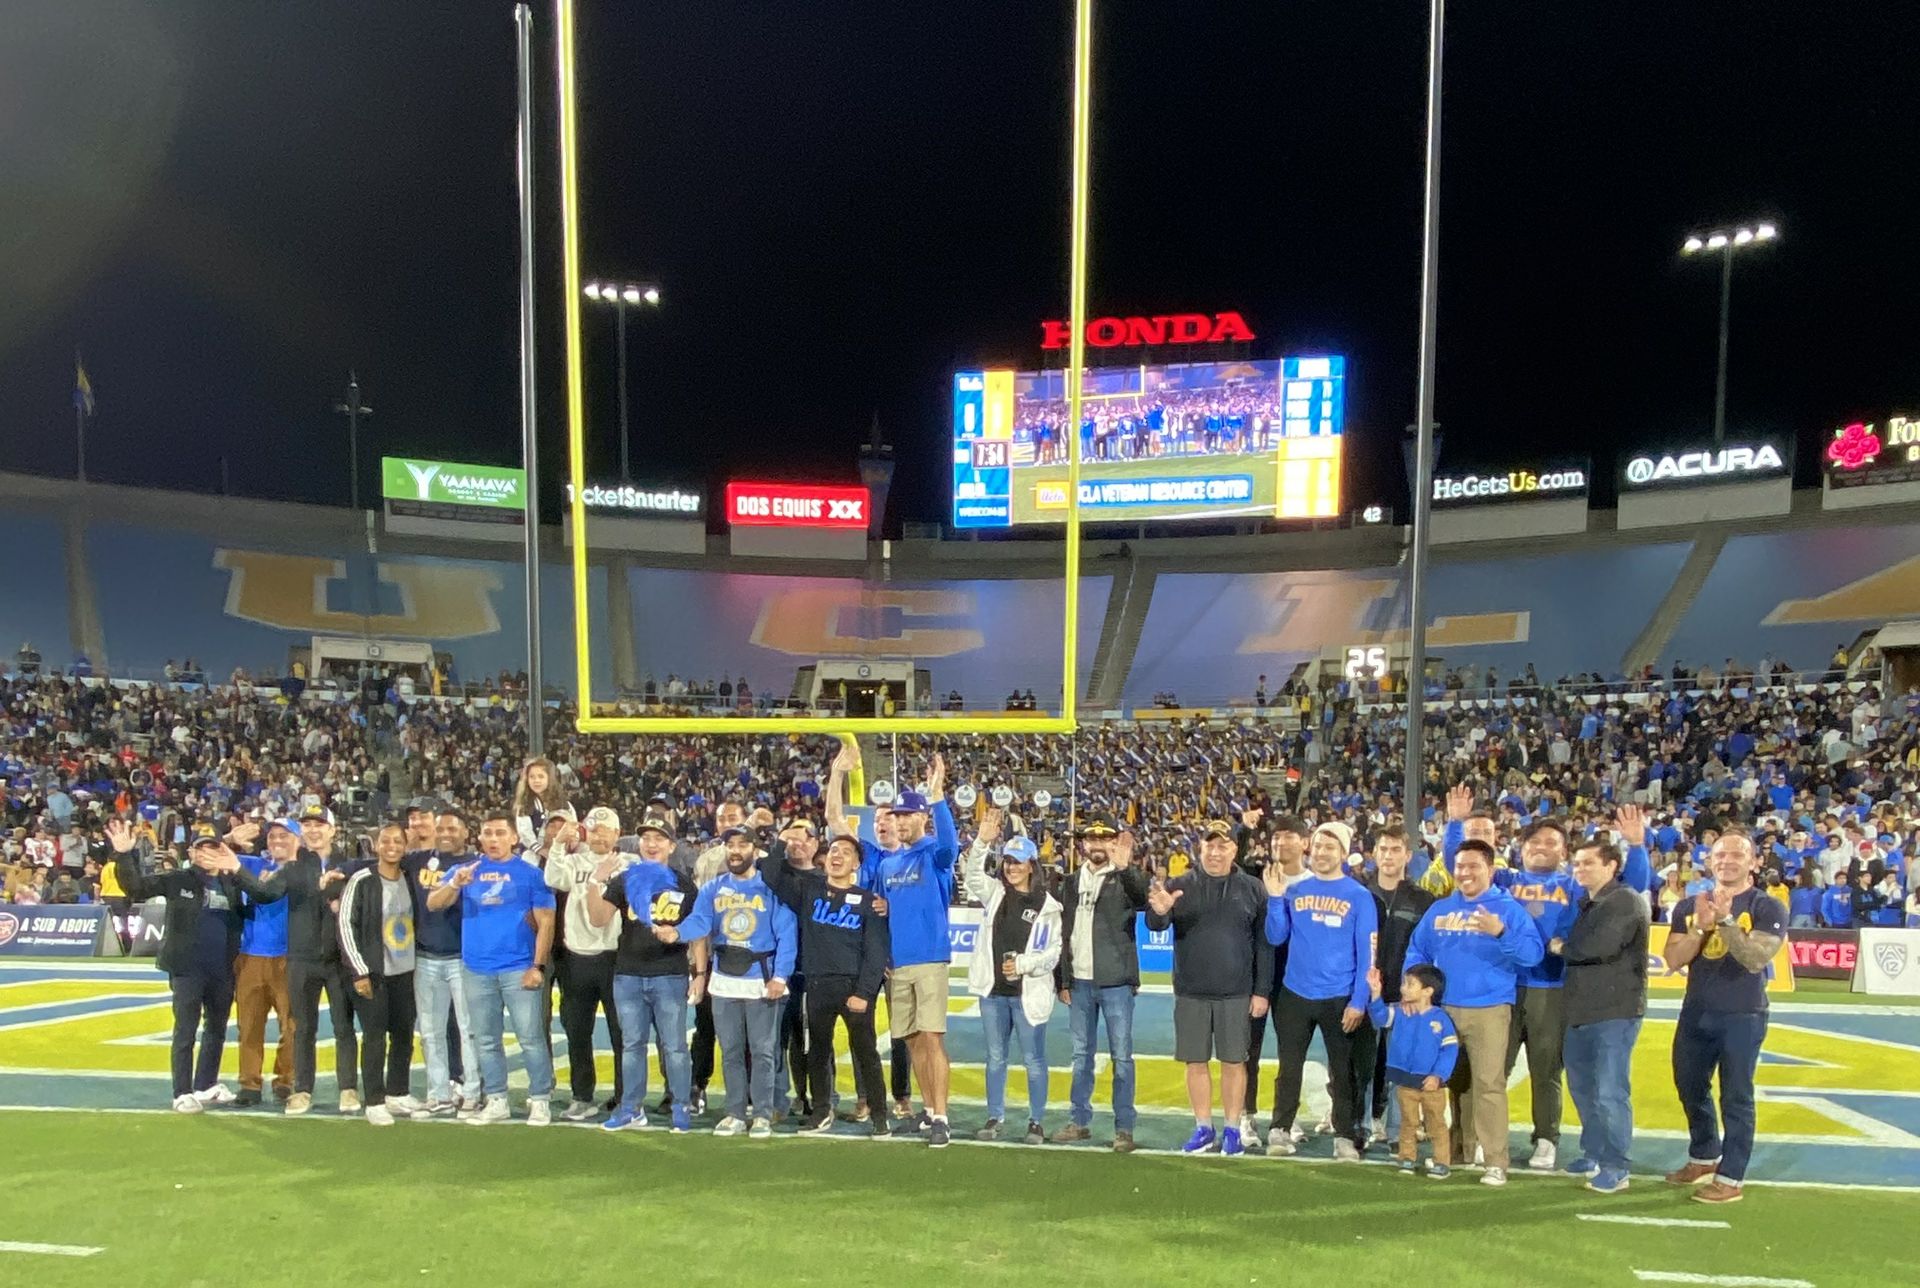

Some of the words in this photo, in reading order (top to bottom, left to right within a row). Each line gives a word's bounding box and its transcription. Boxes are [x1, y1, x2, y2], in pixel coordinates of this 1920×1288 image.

[1042, 312, 1254, 349] HONDA
[1652, 446, 1783, 480] ACURA
[566, 485, 700, 512] TcketSmarter
[1078, 486, 1101, 502] CLA
[1433, 471, 1585, 500] HeGetsUs.com
[736, 495, 769, 516] DOS
[772, 497, 824, 519] EQUIS
[828, 499, 863, 521] XX
[1346, 648, 1385, 679] 25
[480, 872, 511, 882] UCLA
[812, 898, 862, 930] Ucla
[1295, 895, 1351, 918] BRUINS
[20, 917, 30, 932] A
[32, 917, 57, 933] SUB
[58, 918, 99, 934] ABOVE
[1885, 963, 1899, 974] 12
